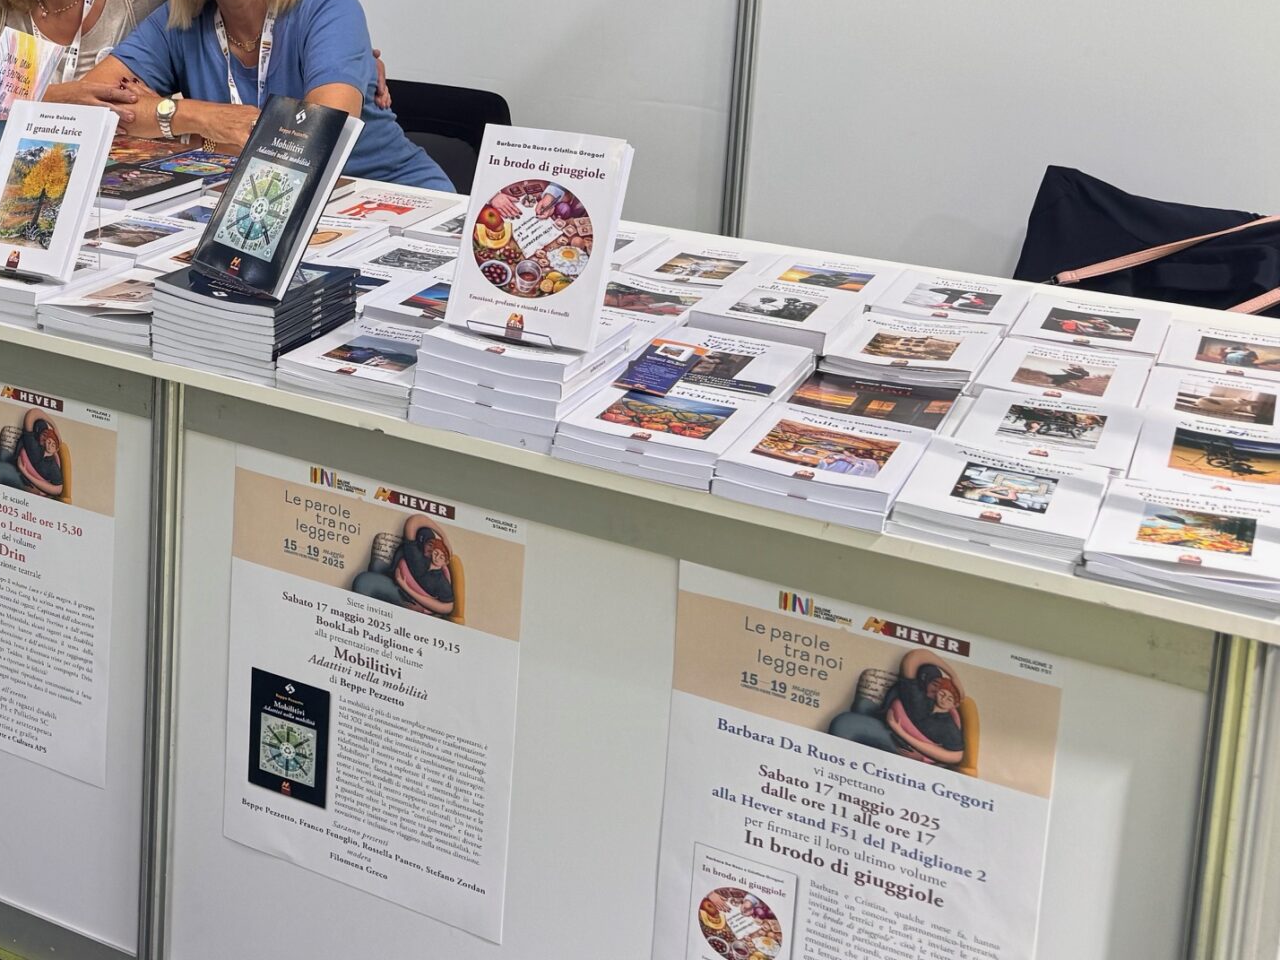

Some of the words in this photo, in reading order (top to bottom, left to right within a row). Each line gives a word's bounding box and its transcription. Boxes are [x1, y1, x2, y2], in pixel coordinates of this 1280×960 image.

[25, 122, 32, 132] Il
[33, 124, 60, 137] grande
[61, 127, 82, 137] larice
[271, 137, 305, 154] Mobilitivi
[488, 154, 500, 165] In
[503, 156, 535, 170] brodo
[538, 161, 550, 172] di
[551, 164, 606, 180] giuggiole
[19, 391, 58, 409] HEVER
[9, 520, 43, 541] Lettura
[21, 510, 37, 523] alle
[39, 517, 54, 528] ore
[56, 521, 83, 537] 15,30
[282, 591, 314, 610] Sabato
[316, 600, 328, 613] 17
[330, 605, 365, 625] maggio
[367, 615, 392, 633] 2025
[394, 624, 411, 638] alle
[413, 632, 429, 645] ore
[432, 637, 461, 655] 19,15
[315, 614, 360, 637] BookLab
[362, 626, 413, 655] Padiglione
[416, 646, 423, 657] 4
[895, 625, 960, 653] HEVER
[333, 646, 402, 680] Mobilitivi
[717, 718, 775, 746] Barbara
[779, 735, 802, 754] Da
[807, 744, 845, 768] Ruos
[849, 759, 858, 770] e
[862, 761, 926, 792] Cristina
[931, 781, 995, 813] Gregori
[744, 829, 763, 849] In
[770, 837, 825, 869] brodo
[830, 857, 849, 877] di
[853, 867, 945, 910] giuggiole
